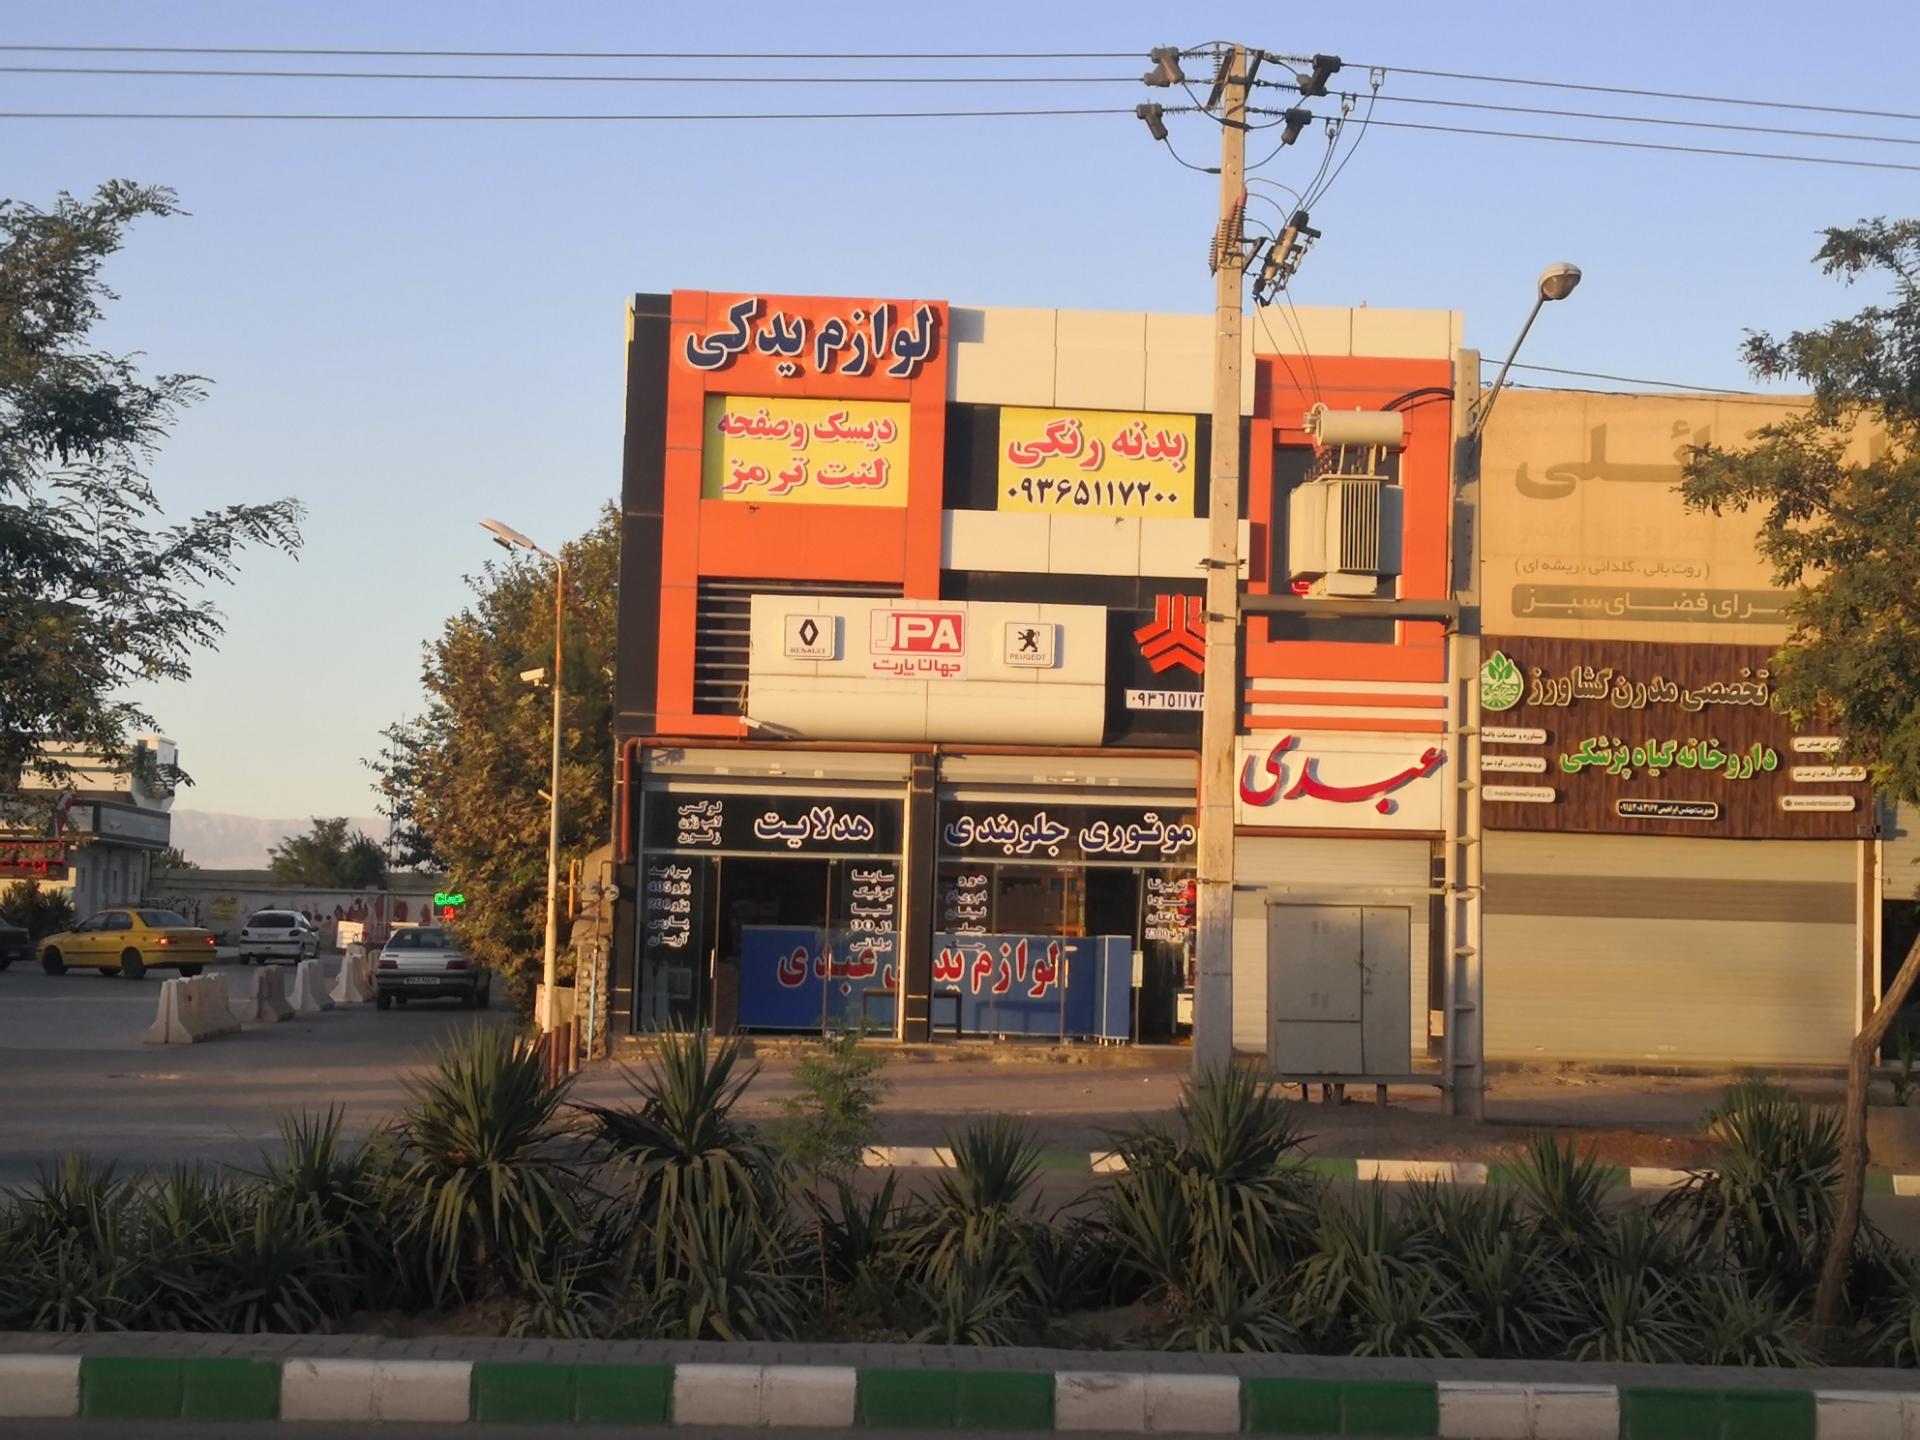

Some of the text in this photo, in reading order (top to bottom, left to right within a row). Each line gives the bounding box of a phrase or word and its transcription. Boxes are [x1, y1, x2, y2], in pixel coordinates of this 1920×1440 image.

[685, 296, 933, 377] لوازم یدکی
[813, 411, 898, 451] دیسک
[1008, 418, 1188, 472] بدنه رنگی
[721, 455, 891, 494] لنت ترمز
[1008, 477, 1178, 506] ۰۹۳۶۵۱۱۷۲۰۰
[1523, 588, 1602, 614] سبز
[1604, 592, 1709, 617] فضای
[875, 615, 960, 650] JPA
[1009, 652, 1046, 662] PEUGEOT
[1528, 665, 1613, 707] کشاورز
[1611, 676, 1679, 709] مدرن
[1680, 669, 1771, 712] تخصصی
[1240, 735, 1445, 815] عبدی
[1559, 736, 1778, 780] داروخانه گیاه پزشکی
[678, 800, 723, 816] لوکس
[754, 806, 874, 848] هدلایت
[944, 811, 1196, 857] موتوری جلوبندی
[777, 946, 878, 996] عبدی
[971, 938, 1060, 997] لوازم
